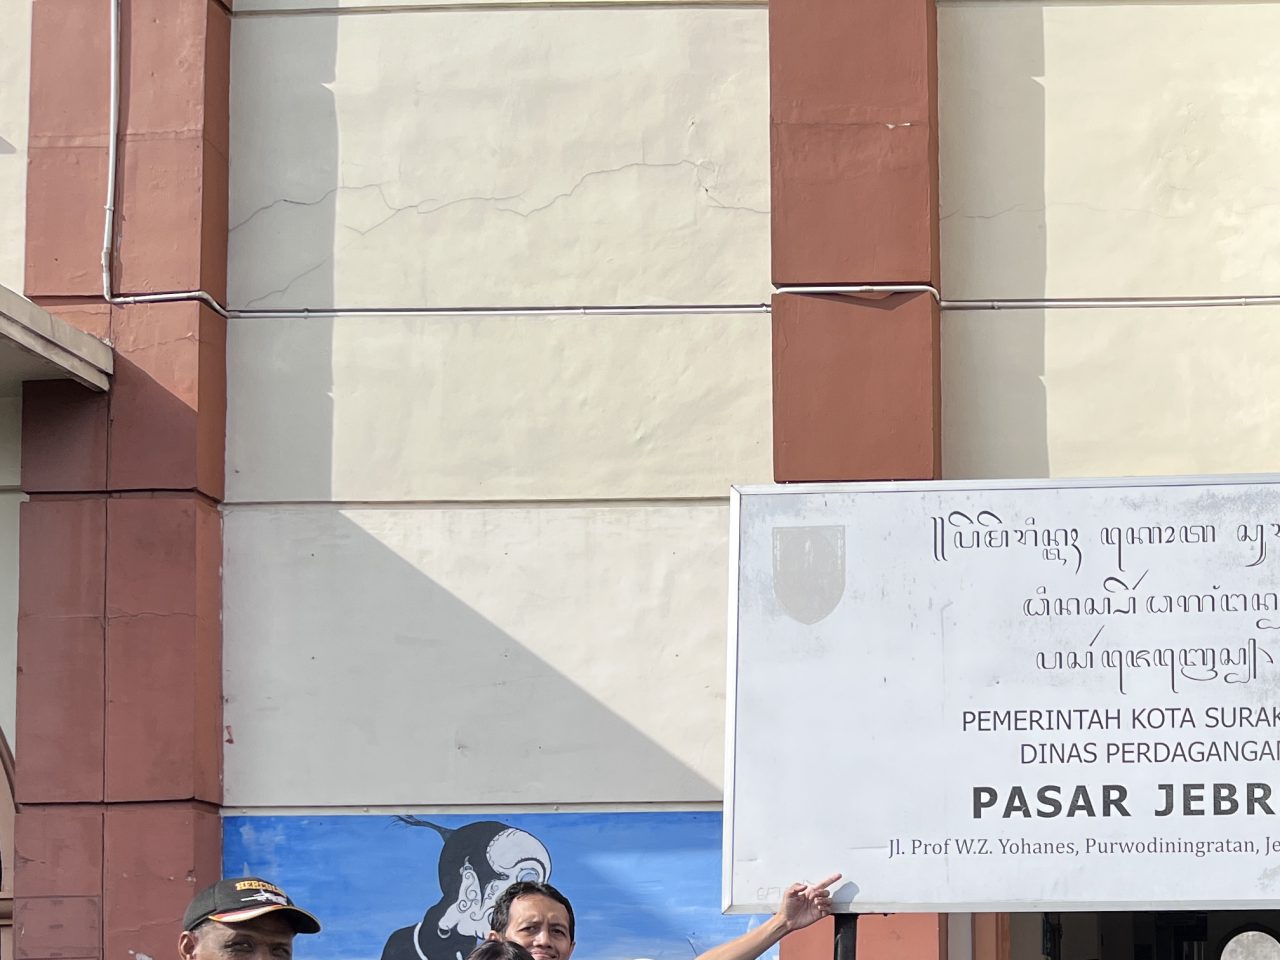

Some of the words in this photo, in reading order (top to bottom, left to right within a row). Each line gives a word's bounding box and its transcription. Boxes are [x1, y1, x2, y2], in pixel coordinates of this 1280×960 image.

[962, 708, 1121, 732] PEMERINTAH
[1131, 707, 1196, 730] KOTA
[1020, 742, 1098, 765] DINAS
[972, 784, 1132, 820] PASAR
[888, 838, 905, 859] Jl.
[911, 838, 952, 855] Prof
[955, 838, 993, 855] W.Z.
[998, 837, 1079, 857] Yohanes,
[1085, 836, 1260, 858] Purwodiningratan,
